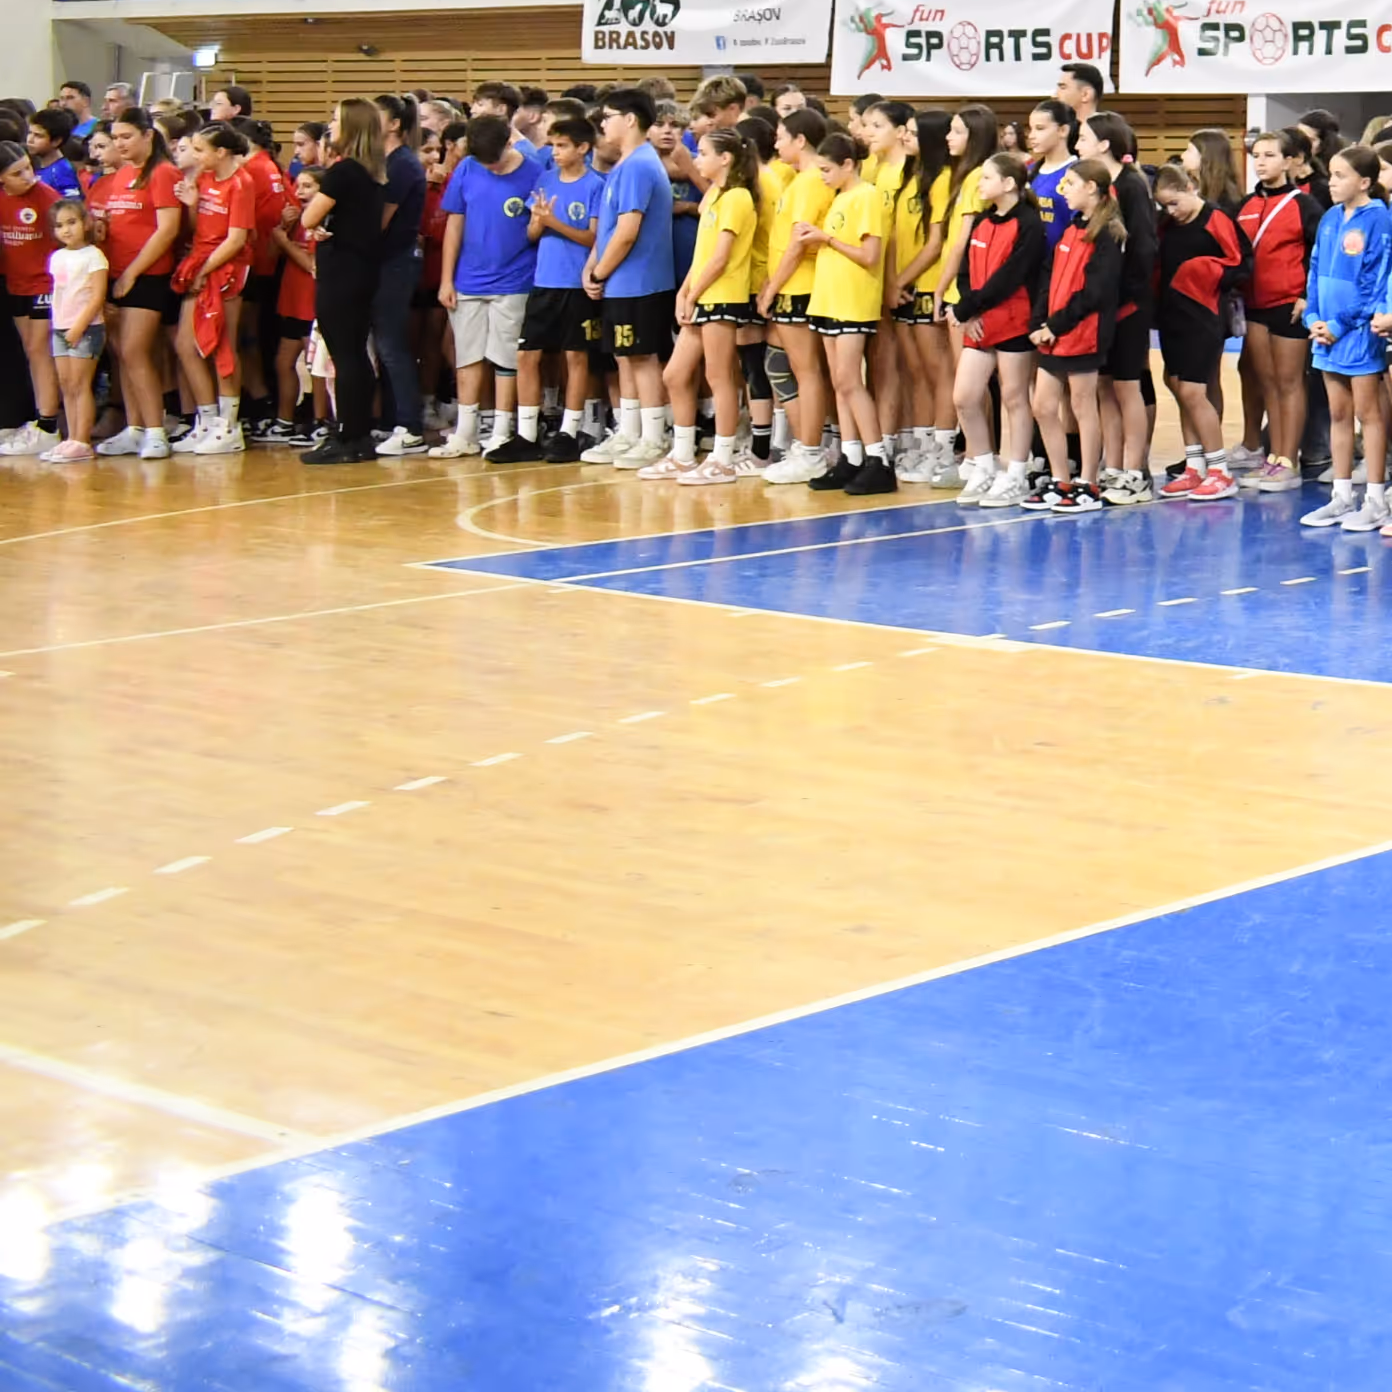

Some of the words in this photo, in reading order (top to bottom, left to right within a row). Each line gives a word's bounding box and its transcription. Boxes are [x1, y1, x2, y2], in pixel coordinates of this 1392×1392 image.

[908, 4, 945, 25] fun
[593, 30, 675, 50] BRASOV
[1058, 31, 1111, 60] CUP
